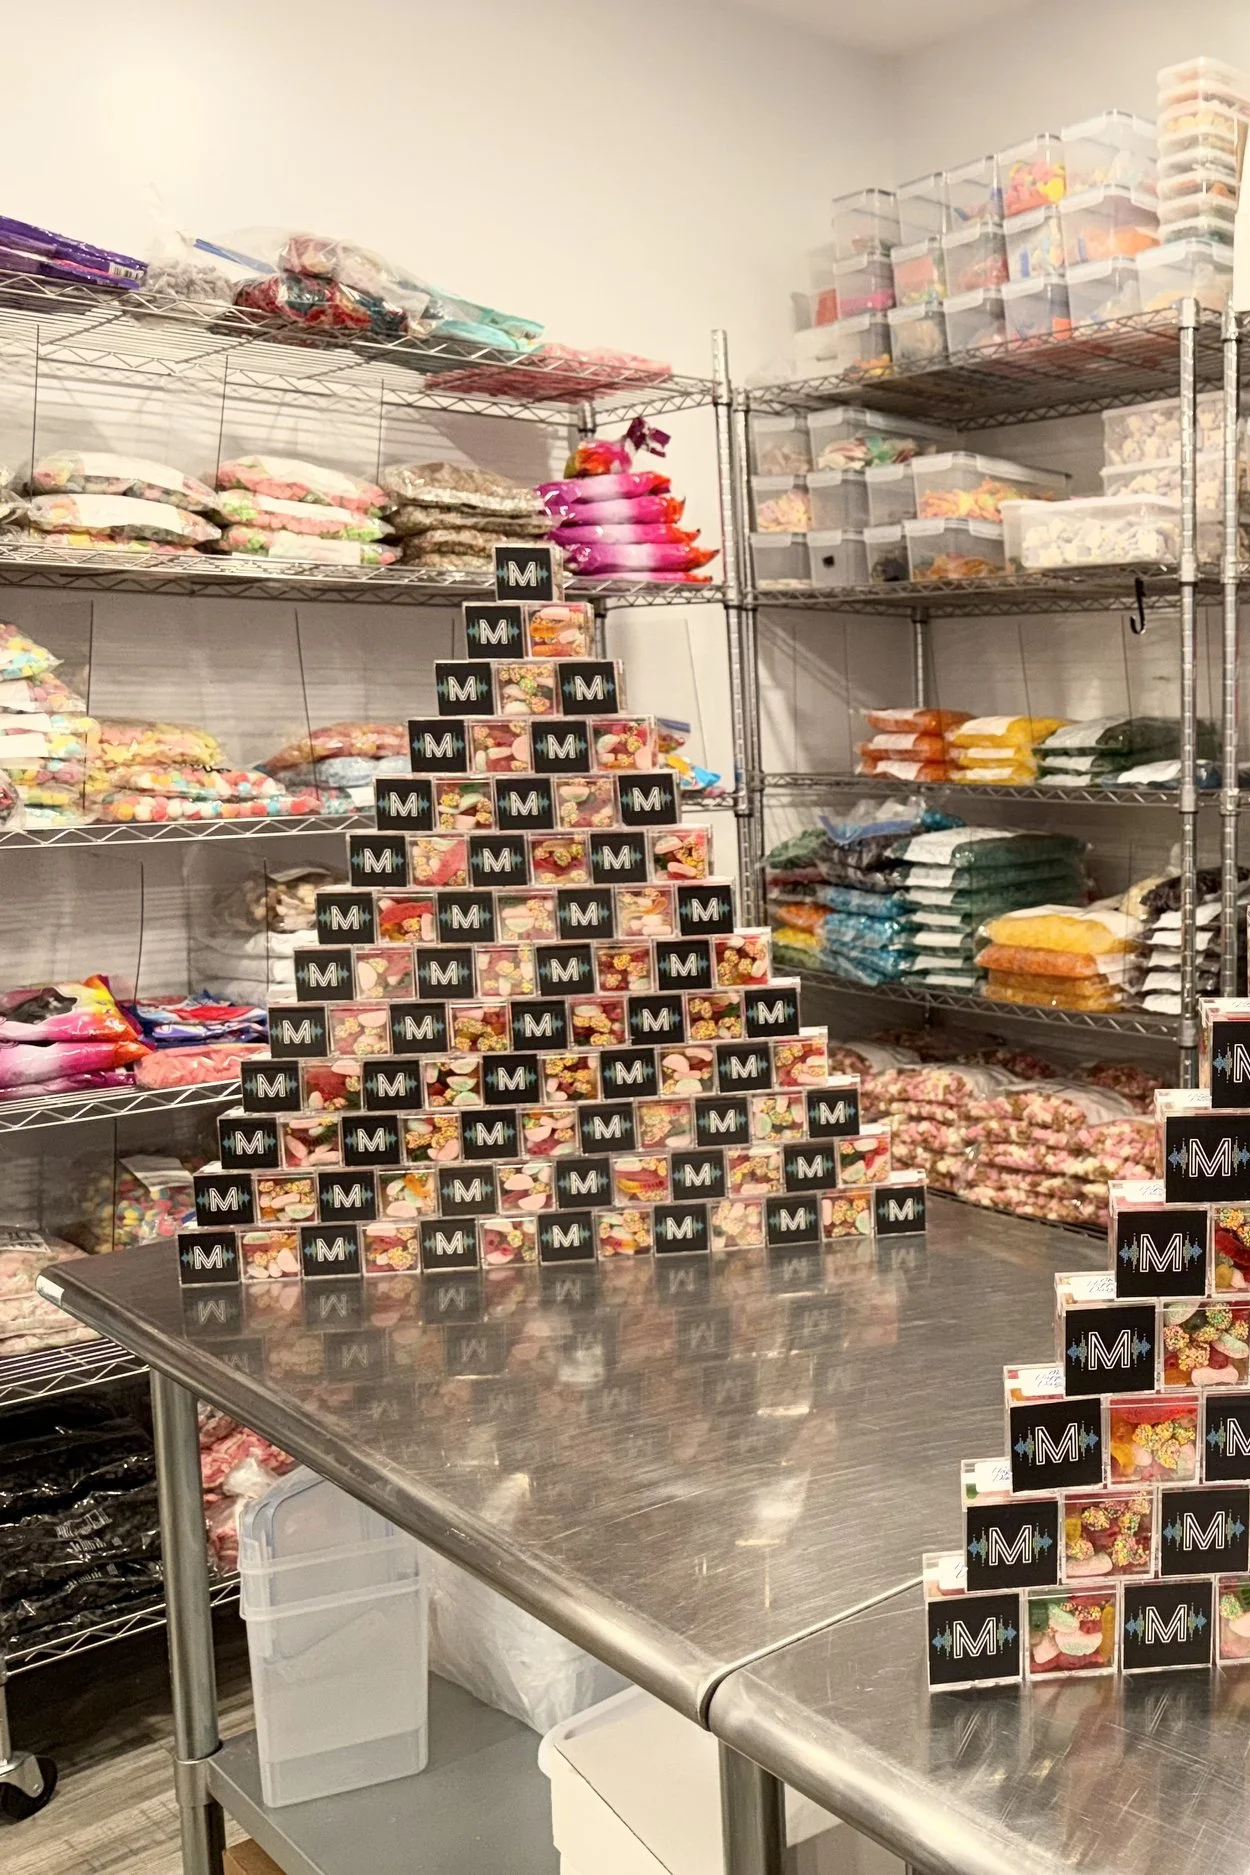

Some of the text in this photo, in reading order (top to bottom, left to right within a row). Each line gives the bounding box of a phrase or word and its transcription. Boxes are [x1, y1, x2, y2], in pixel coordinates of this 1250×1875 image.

[509, 561, 536, 586] M
[480, 620, 507, 644] M
[448, 676, 476, 701] M
[575, 676, 603, 700] M
[425, 733, 452, 757] M
[548, 734, 575, 758] M
[390, 792, 417, 816] M
[510, 791, 538, 815] M
[633, 787, 660, 811] M
[364, 849, 391, 872] M
[483, 848, 511, 872] M
[603, 846, 631, 870] M
[331, 906, 359, 929] M
[451, 905, 480, 928] M
[570, 902, 598, 926] M
[692, 898, 719, 921] M
[309, 963, 338, 987] M
[430, 961, 458, 985] M
[551, 958, 579, 982] M
[670, 953, 697, 976] M
[643, 1008, 669, 1031] M
[758, 1001, 784, 1024] M
[283, 1020, 311, 1044] M
[405, 1016, 433, 1039] M
[524, 1013, 551, 1037] M
[498, 1067, 525, 1090] M
[616, 1061, 643, 1084] M
[731, 1055, 757, 1078] M
[257, 1074, 285, 1097] M
[378, 1073, 405, 1096] M
[710, 1110, 736, 1133] M
[820, 1101, 845, 1124] M
[477, 1122, 503, 1145] M
[593, 1115, 621, 1139] M
[235, 1131, 264, 1154] M
[358, 1128, 385, 1151] M
[798, 1155, 823, 1178] M
[1189, 1138, 1231, 1177] M
[570, 1171, 598, 1194] M
[684, 1163, 711, 1186] M
[210, 1187, 238, 1211] M
[334, 1184, 361, 1208] M
[454, 1179, 482, 1202] M
[780, 1208, 806, 1231] M
[889, 1198, 914, 1221] M
[552, 1224, 580, 1248] M
[666, 1216, 693, 1239] M
[317, 1238, 344, 1261] M
[435, 1231, 464, 1255] M
[1140, 1234, 1182, 1272] M
[194, 1245, 222, 1269] M
[1089, 1330, 1130, 1370] M
[1036, 1423, 1078, 1465] M
[1184, 1511, 1225, 1550] M
[989, 1525, 1032, 1565] M
[1146, 1605, 1187, 1644] M
[954, 1617, 996, 1658] M
